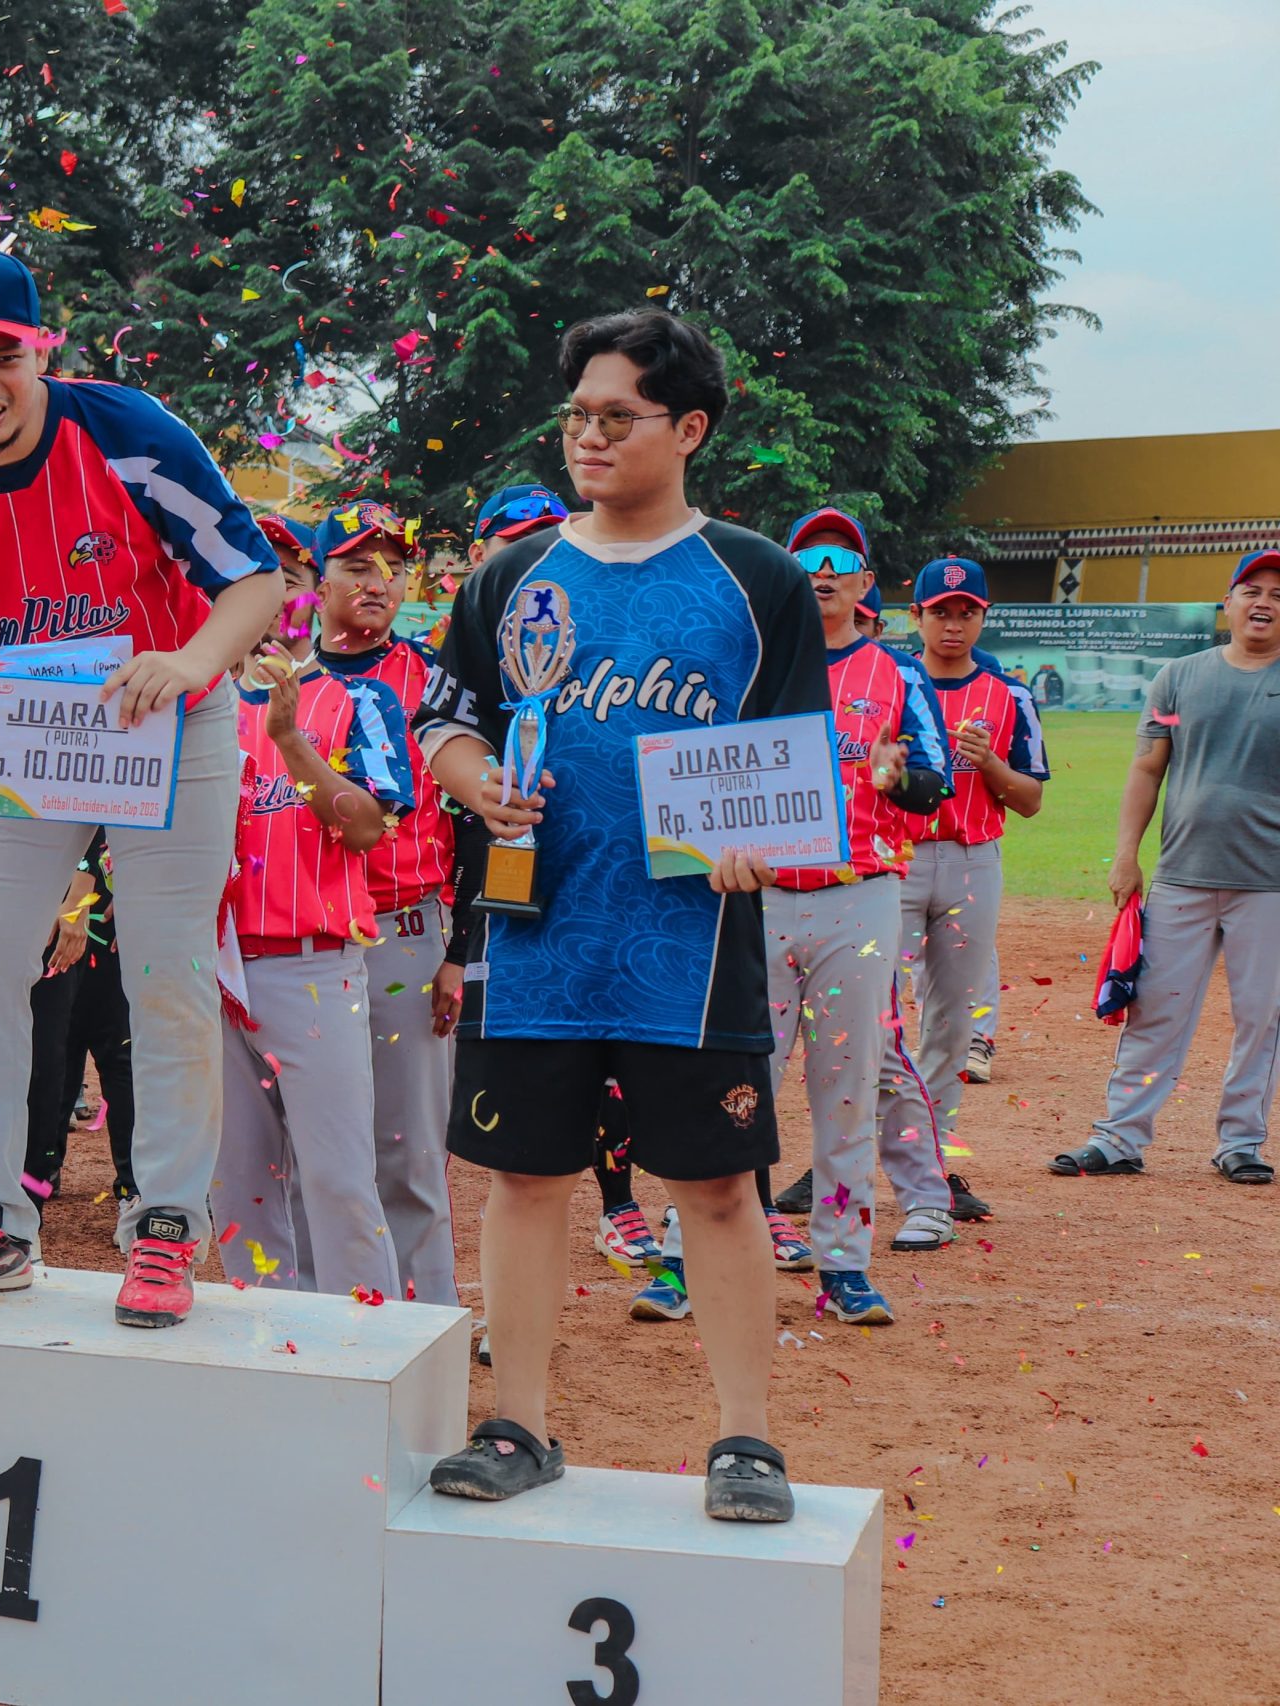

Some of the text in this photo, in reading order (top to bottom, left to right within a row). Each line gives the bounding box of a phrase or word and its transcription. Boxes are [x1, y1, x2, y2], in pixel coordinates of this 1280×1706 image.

[21, 592, 131, 645] Pillars
[1008, 619, 1096, 629] TECHNOLOGY
[1066, 608, 1147, 619] LUBRICANTS
[1000, 630, 1066, 639] INDUSTRIAL
[1086, 630, 1137, 639] FACTORY
[1140, 631, 1212, 641] LUBRICANTS
[546, 656, 718, 727] olphin
[6, 698, 109, 729] JUARA
[23, 748, 163, 788] 10.000.000
[668, 739, 791, 777] JUARA 3
[41, 795, 71, 810] Softball
[123, 800, 138, 817] Cup
[139, 801, 160, 817] 2025
[657, 789, 823, 841] Rp. 3.000.000
[812, 836, 833, 854] 2025
[395, 910, 426, 937] 10
[151, 1220, 182, 1236] ZETT
[565, 1597, 640, 1706] 3
